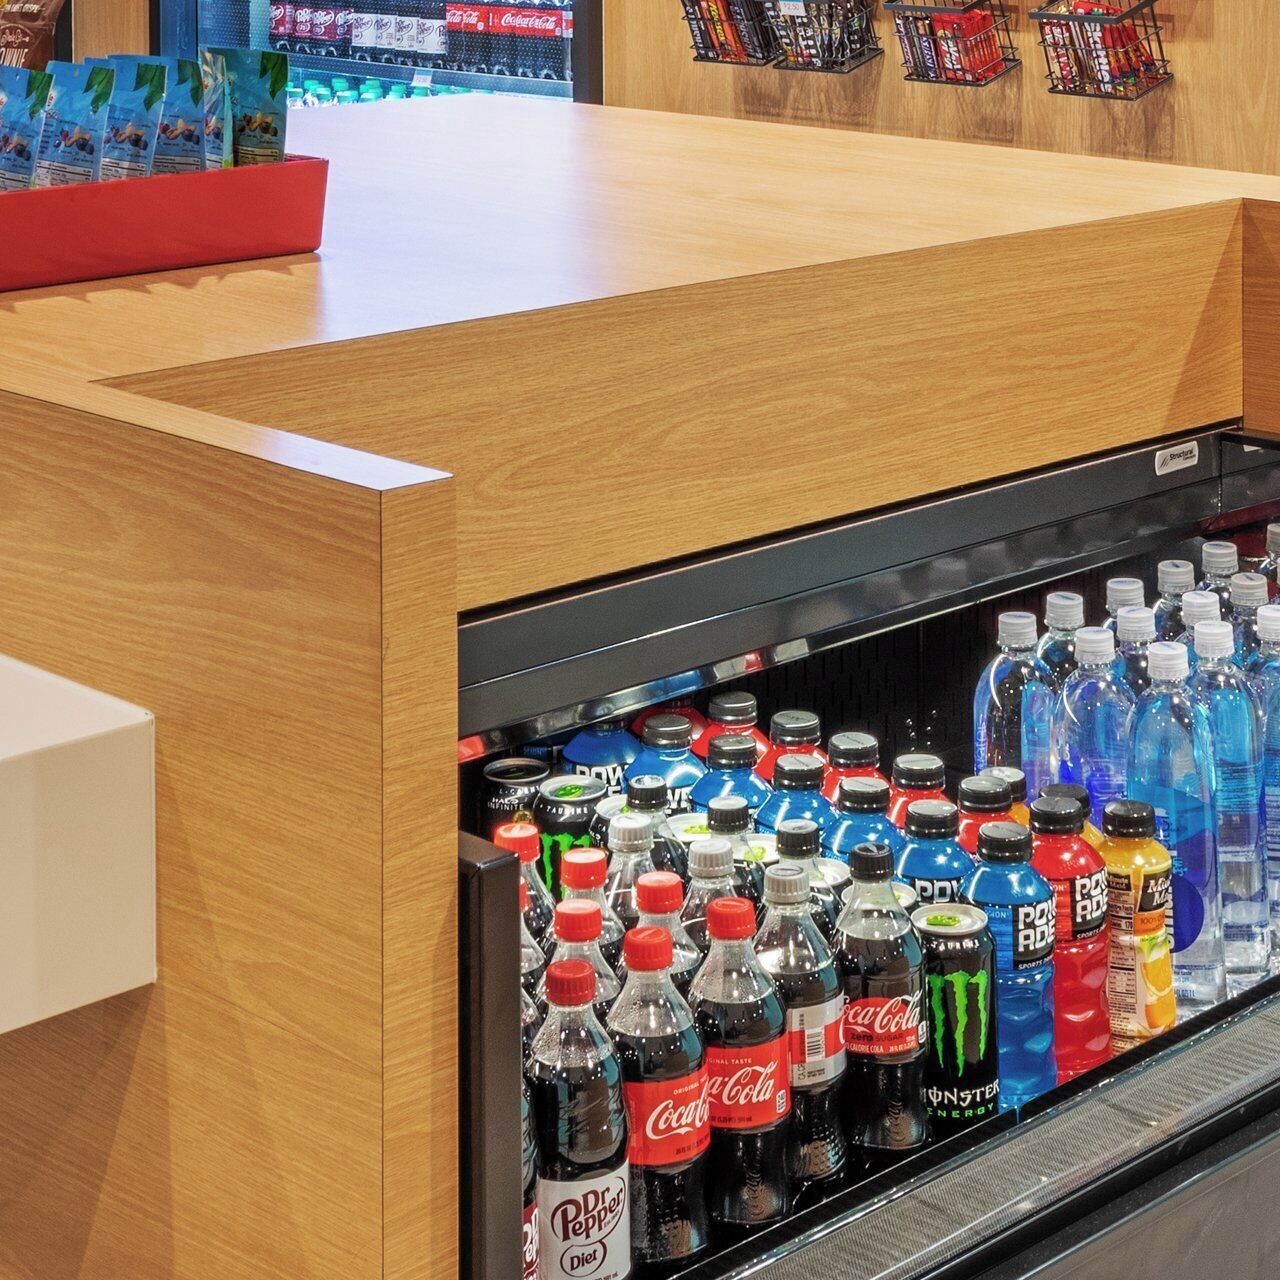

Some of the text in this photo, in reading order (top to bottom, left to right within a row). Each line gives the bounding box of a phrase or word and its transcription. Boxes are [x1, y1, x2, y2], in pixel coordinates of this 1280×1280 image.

[487, 802, 524, 814] INFINITE
[731, 1057, 752, 1065] TASTE
[673, 1083, 699, 1096] ORIGINAL
[582, 1186, 610, 1217] Dr
[551, 1187, 623, 1242] Pepper
[570, 1249, 598, 1271] Diet
